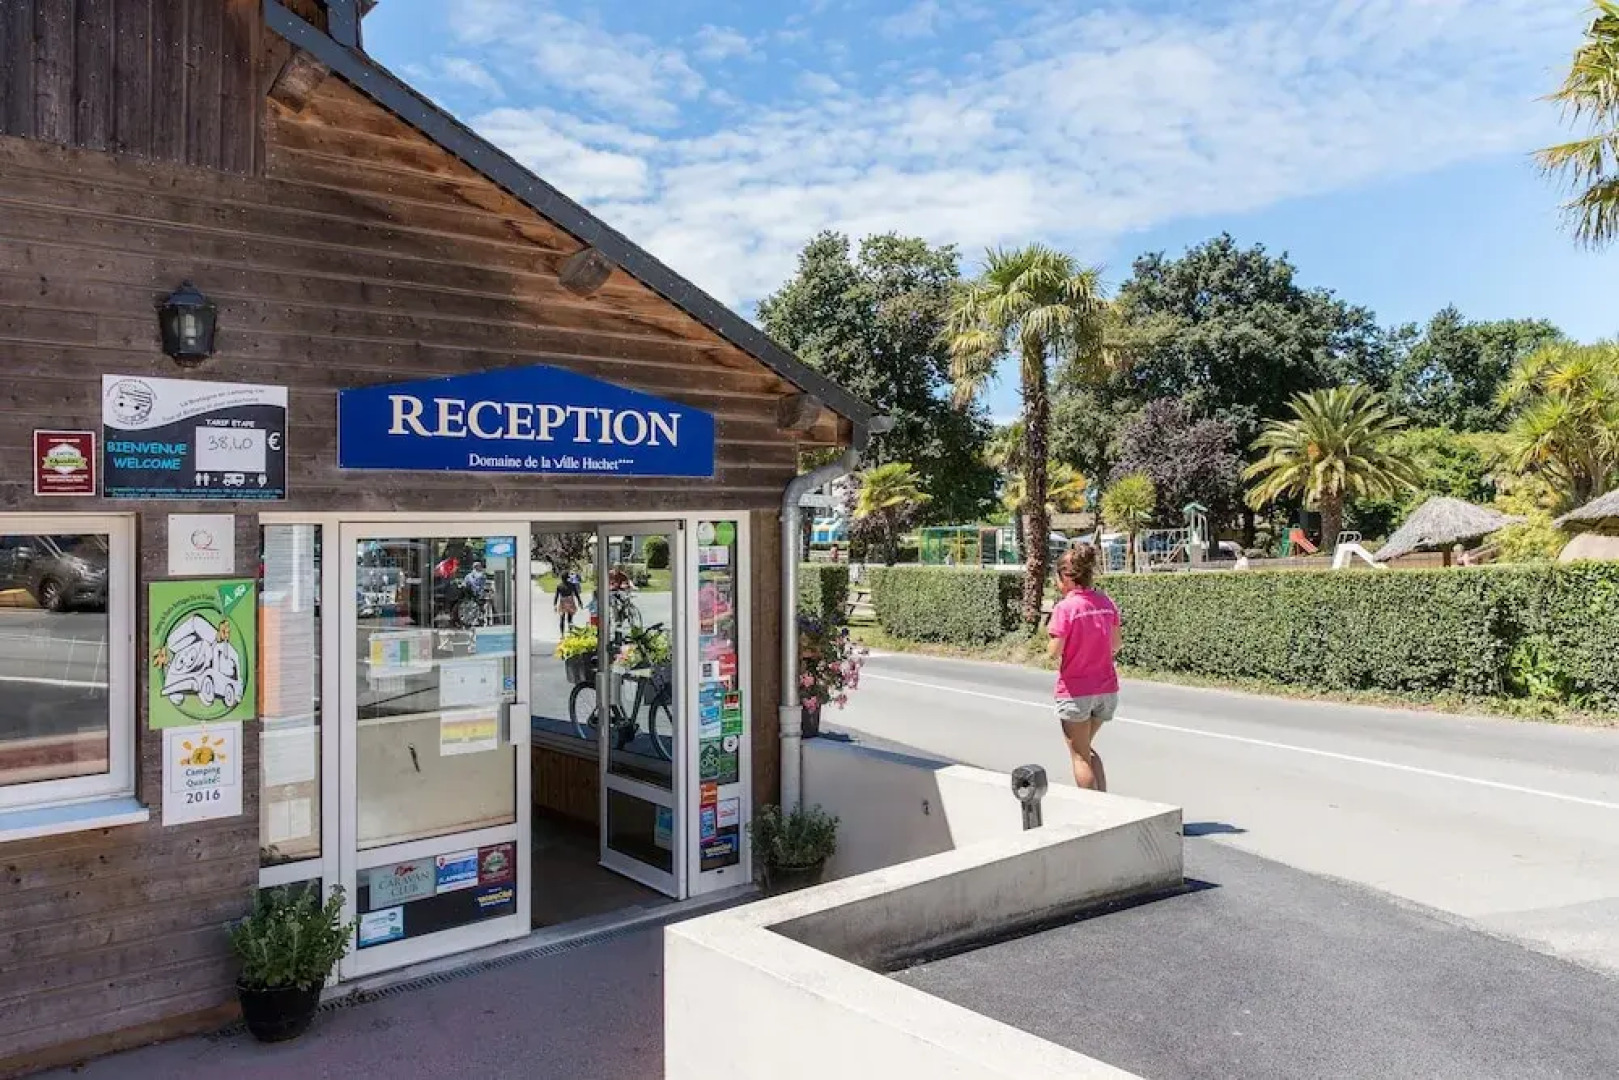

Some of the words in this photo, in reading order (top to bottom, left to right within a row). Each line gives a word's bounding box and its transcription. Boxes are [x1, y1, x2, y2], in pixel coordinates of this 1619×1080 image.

[205, 419, 230, 427] TARIF
[387, 394, 681, 447] RECEPTION
[107, 441, 187, 455] BIENVENUE
[268, 432, 281, 451] €
[113, 457, 181, 470] WELCOME
[468, 453, 522, 467] Domaine
[524, 455, 538, 467] de
[541, 456, 551, 468] la
[552, 455, 579, 469] Ville
[186, 767, 221, 776] Camping
[186, 789, 221, 804] 2016
